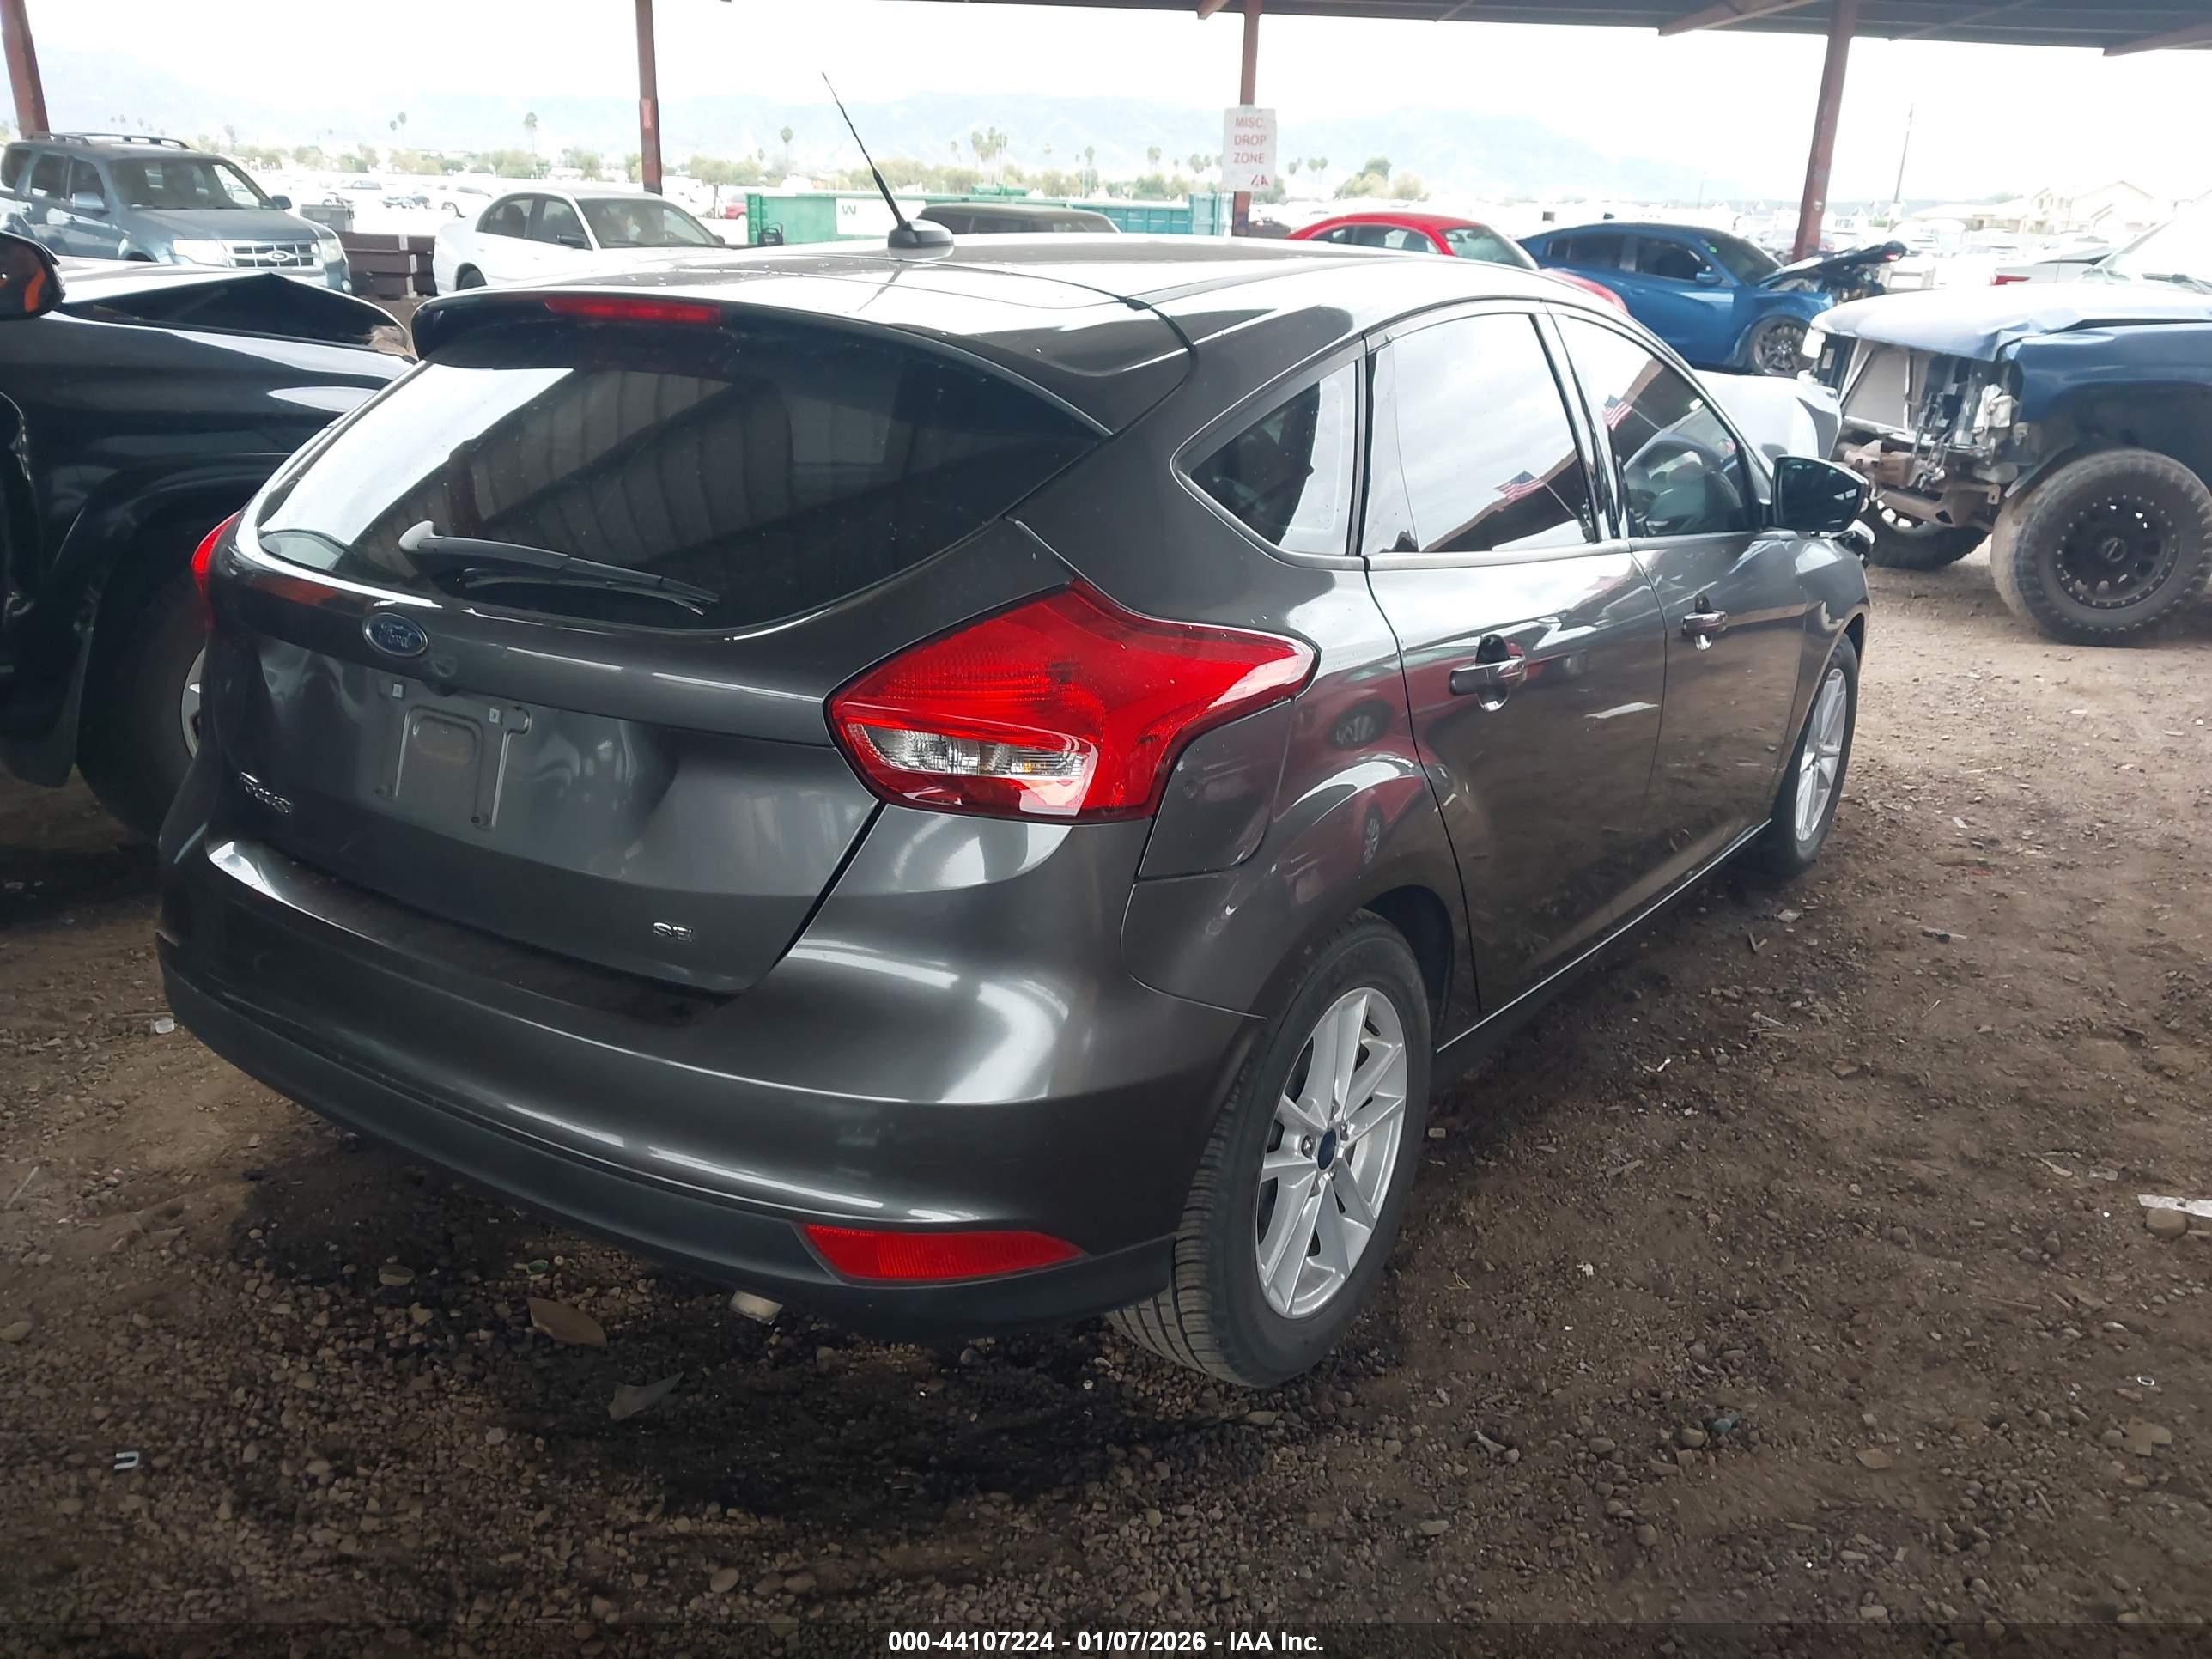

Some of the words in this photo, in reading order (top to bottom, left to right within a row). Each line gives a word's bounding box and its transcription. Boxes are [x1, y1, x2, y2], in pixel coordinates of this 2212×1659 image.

[1234, 134, 1267, 146] DROP
[1233, 152, 1265, 164] ZONE
[653, 922, 692, 942] SE
